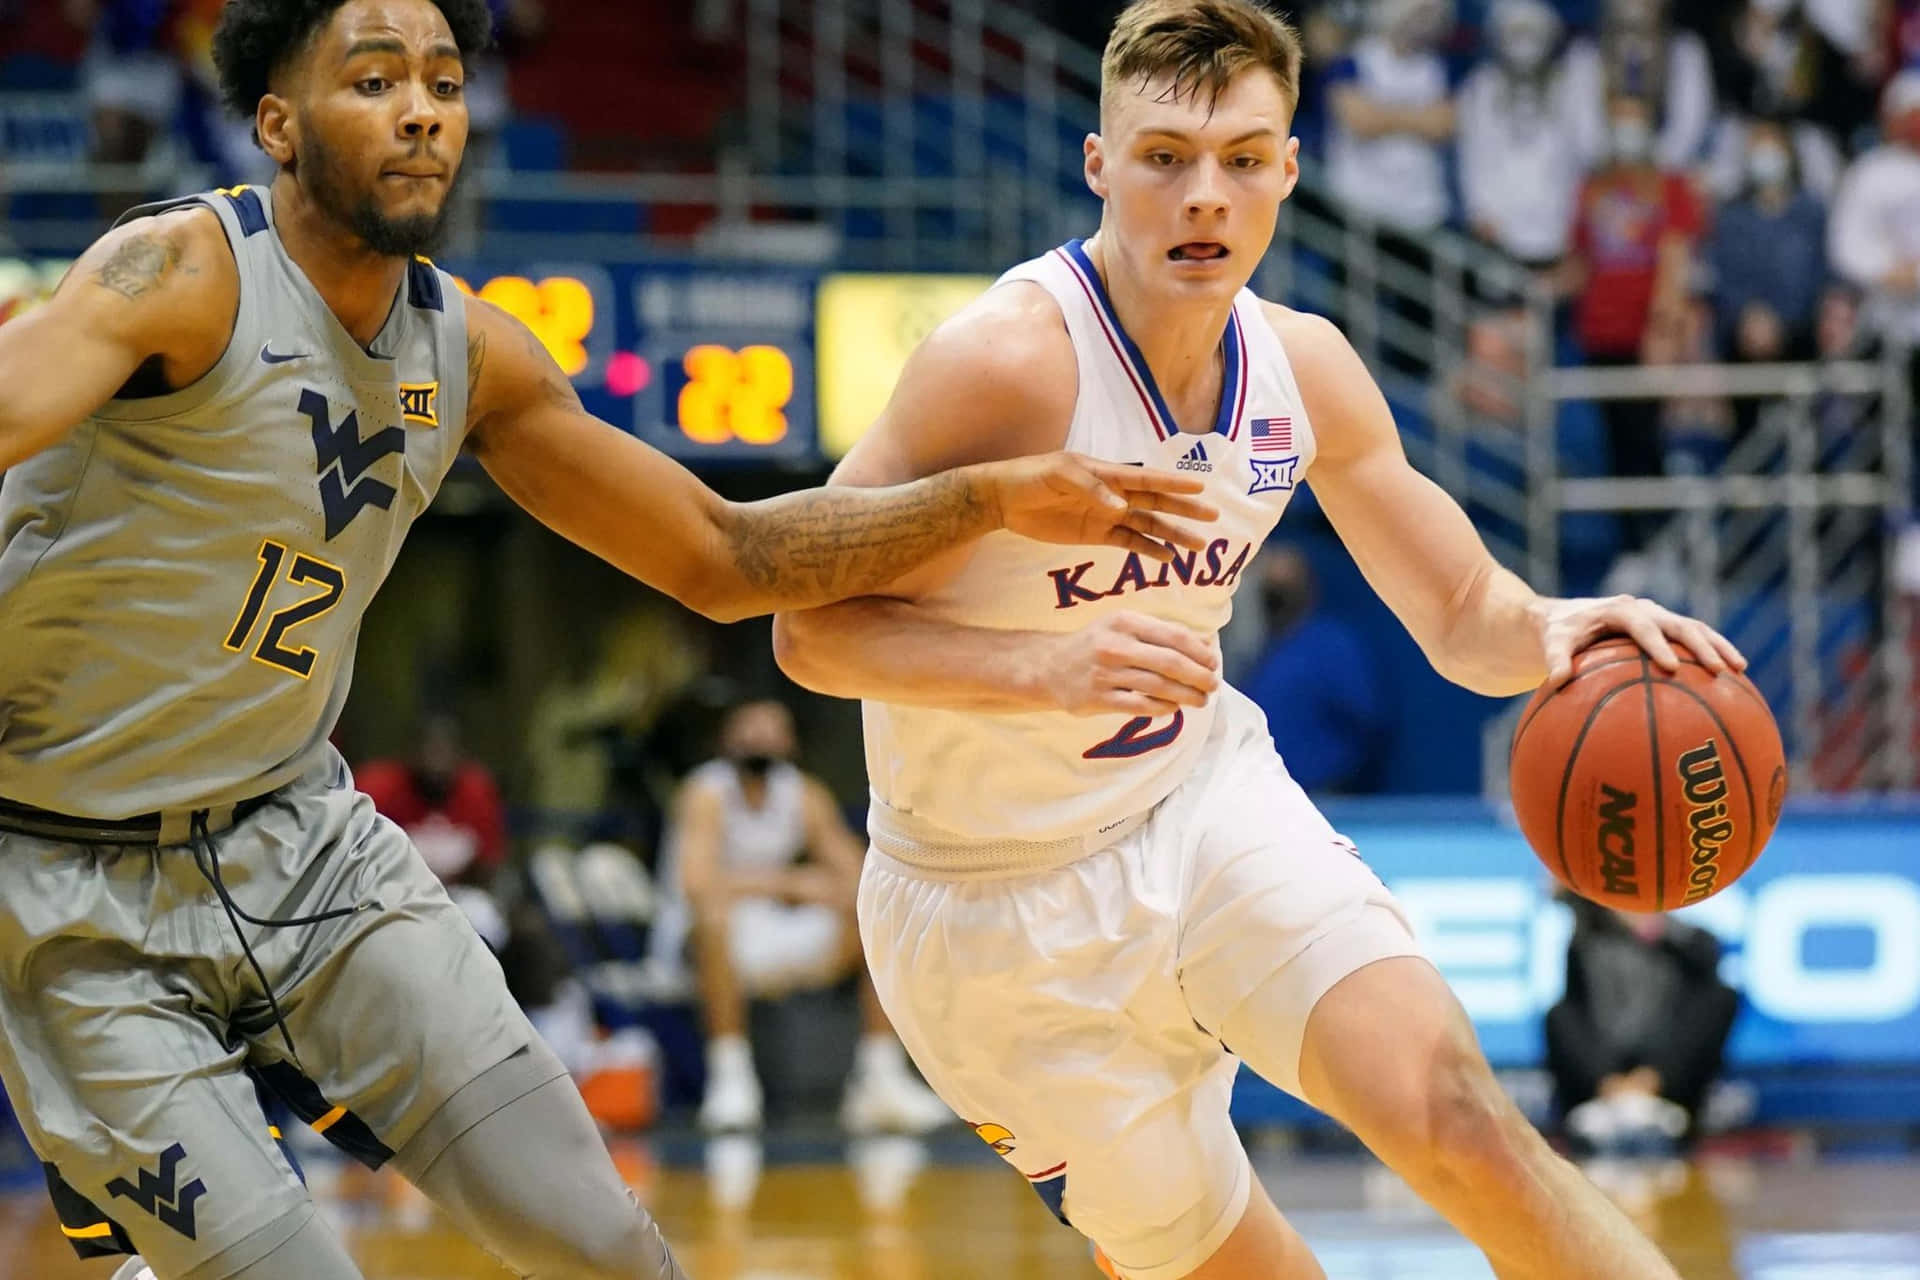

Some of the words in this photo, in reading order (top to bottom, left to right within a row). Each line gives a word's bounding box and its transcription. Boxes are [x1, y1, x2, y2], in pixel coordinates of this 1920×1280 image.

[1176, 459, 1213, 473] adidas
[1248, 456, 1299, 495] XII
[223, 538, 346, 680] 12
[1047, 538, 1252, 609] KANSA
[1597, 782, 1641, 897] NCAA
[1676, 736, 1735, 906] Wilson
